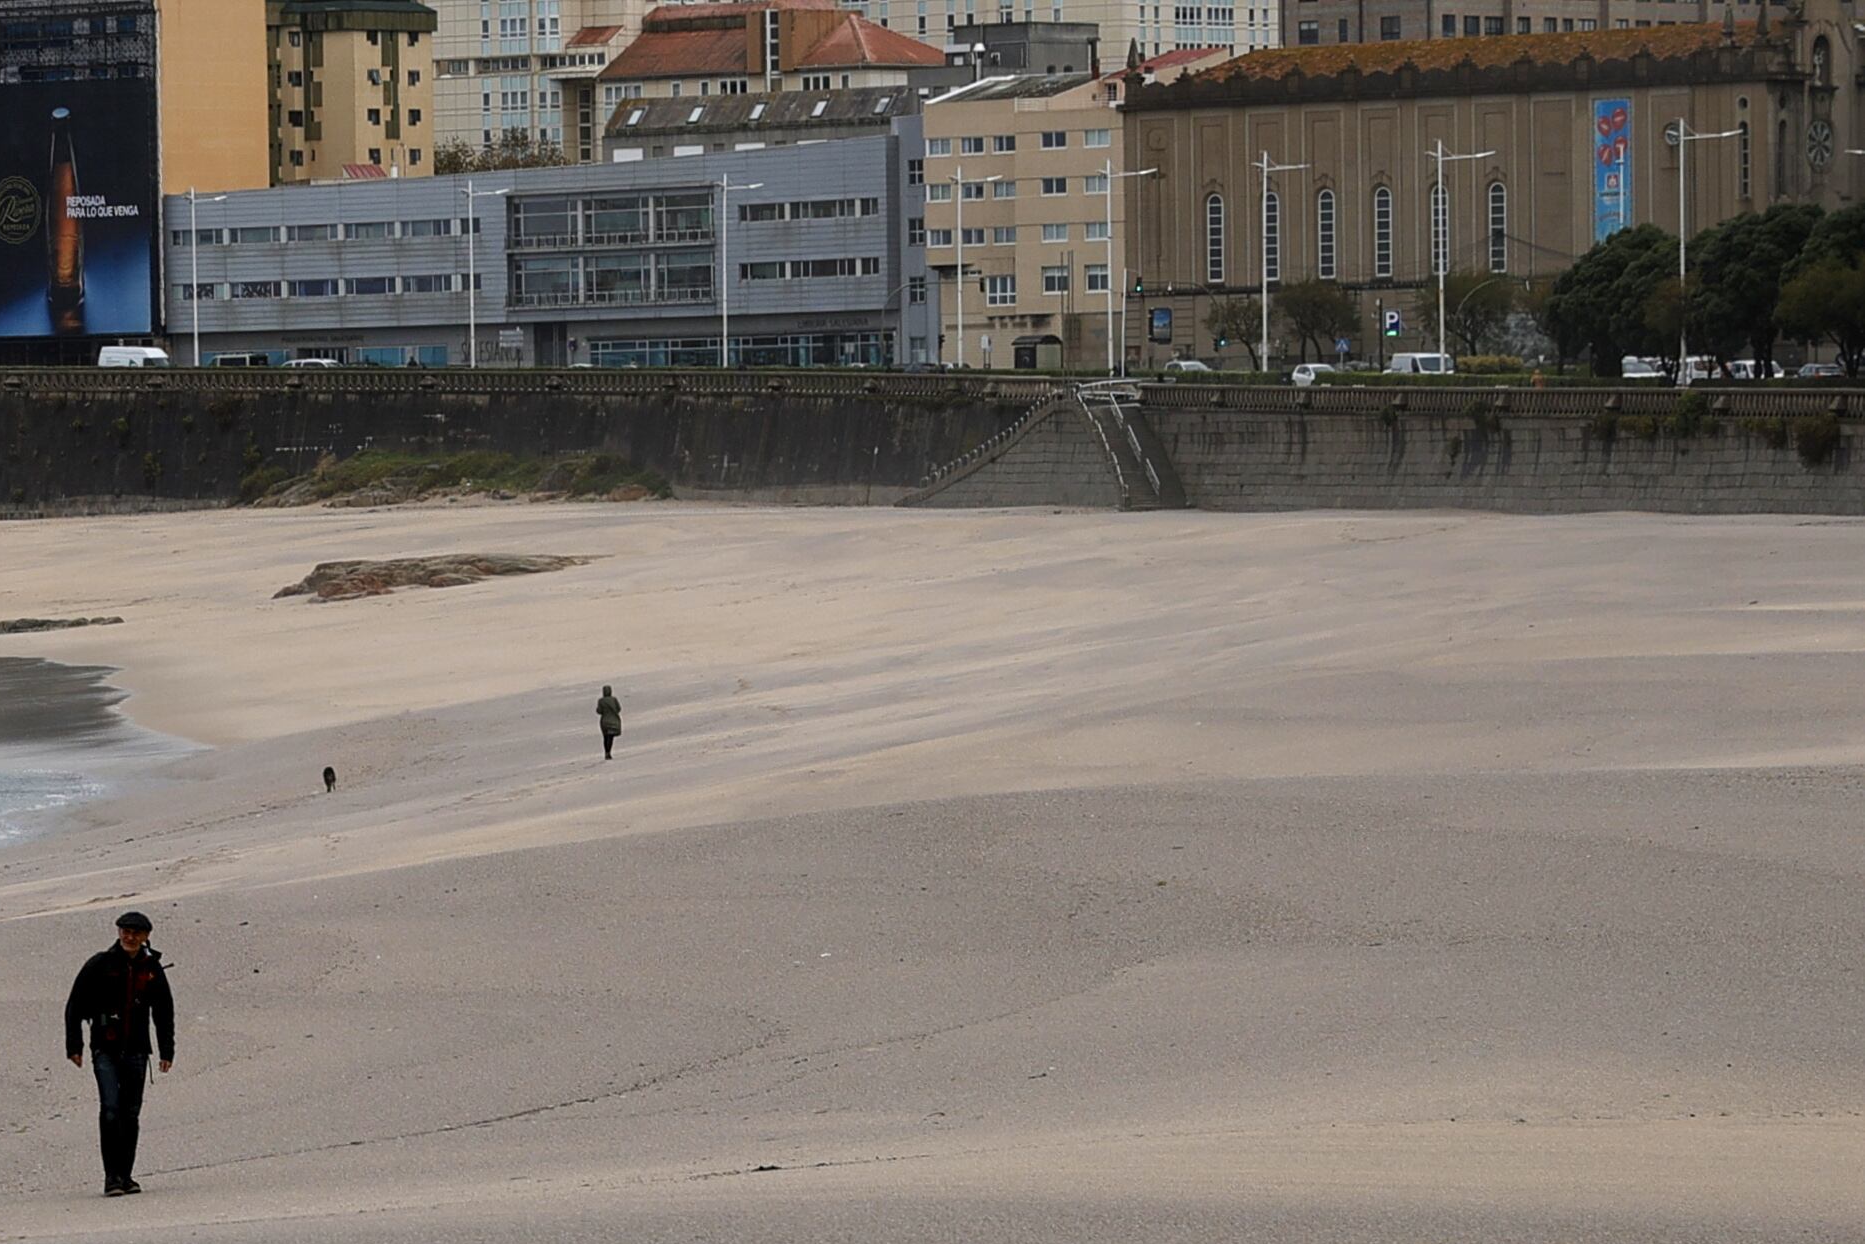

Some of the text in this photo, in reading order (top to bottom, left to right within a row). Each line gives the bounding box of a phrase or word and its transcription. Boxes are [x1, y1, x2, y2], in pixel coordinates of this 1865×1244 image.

[66, 195, 106, 207] REPOSADA
[66, 204, 139, 219] PARA LO QUE VENGA
[1385, 311, 1399, 329] P
